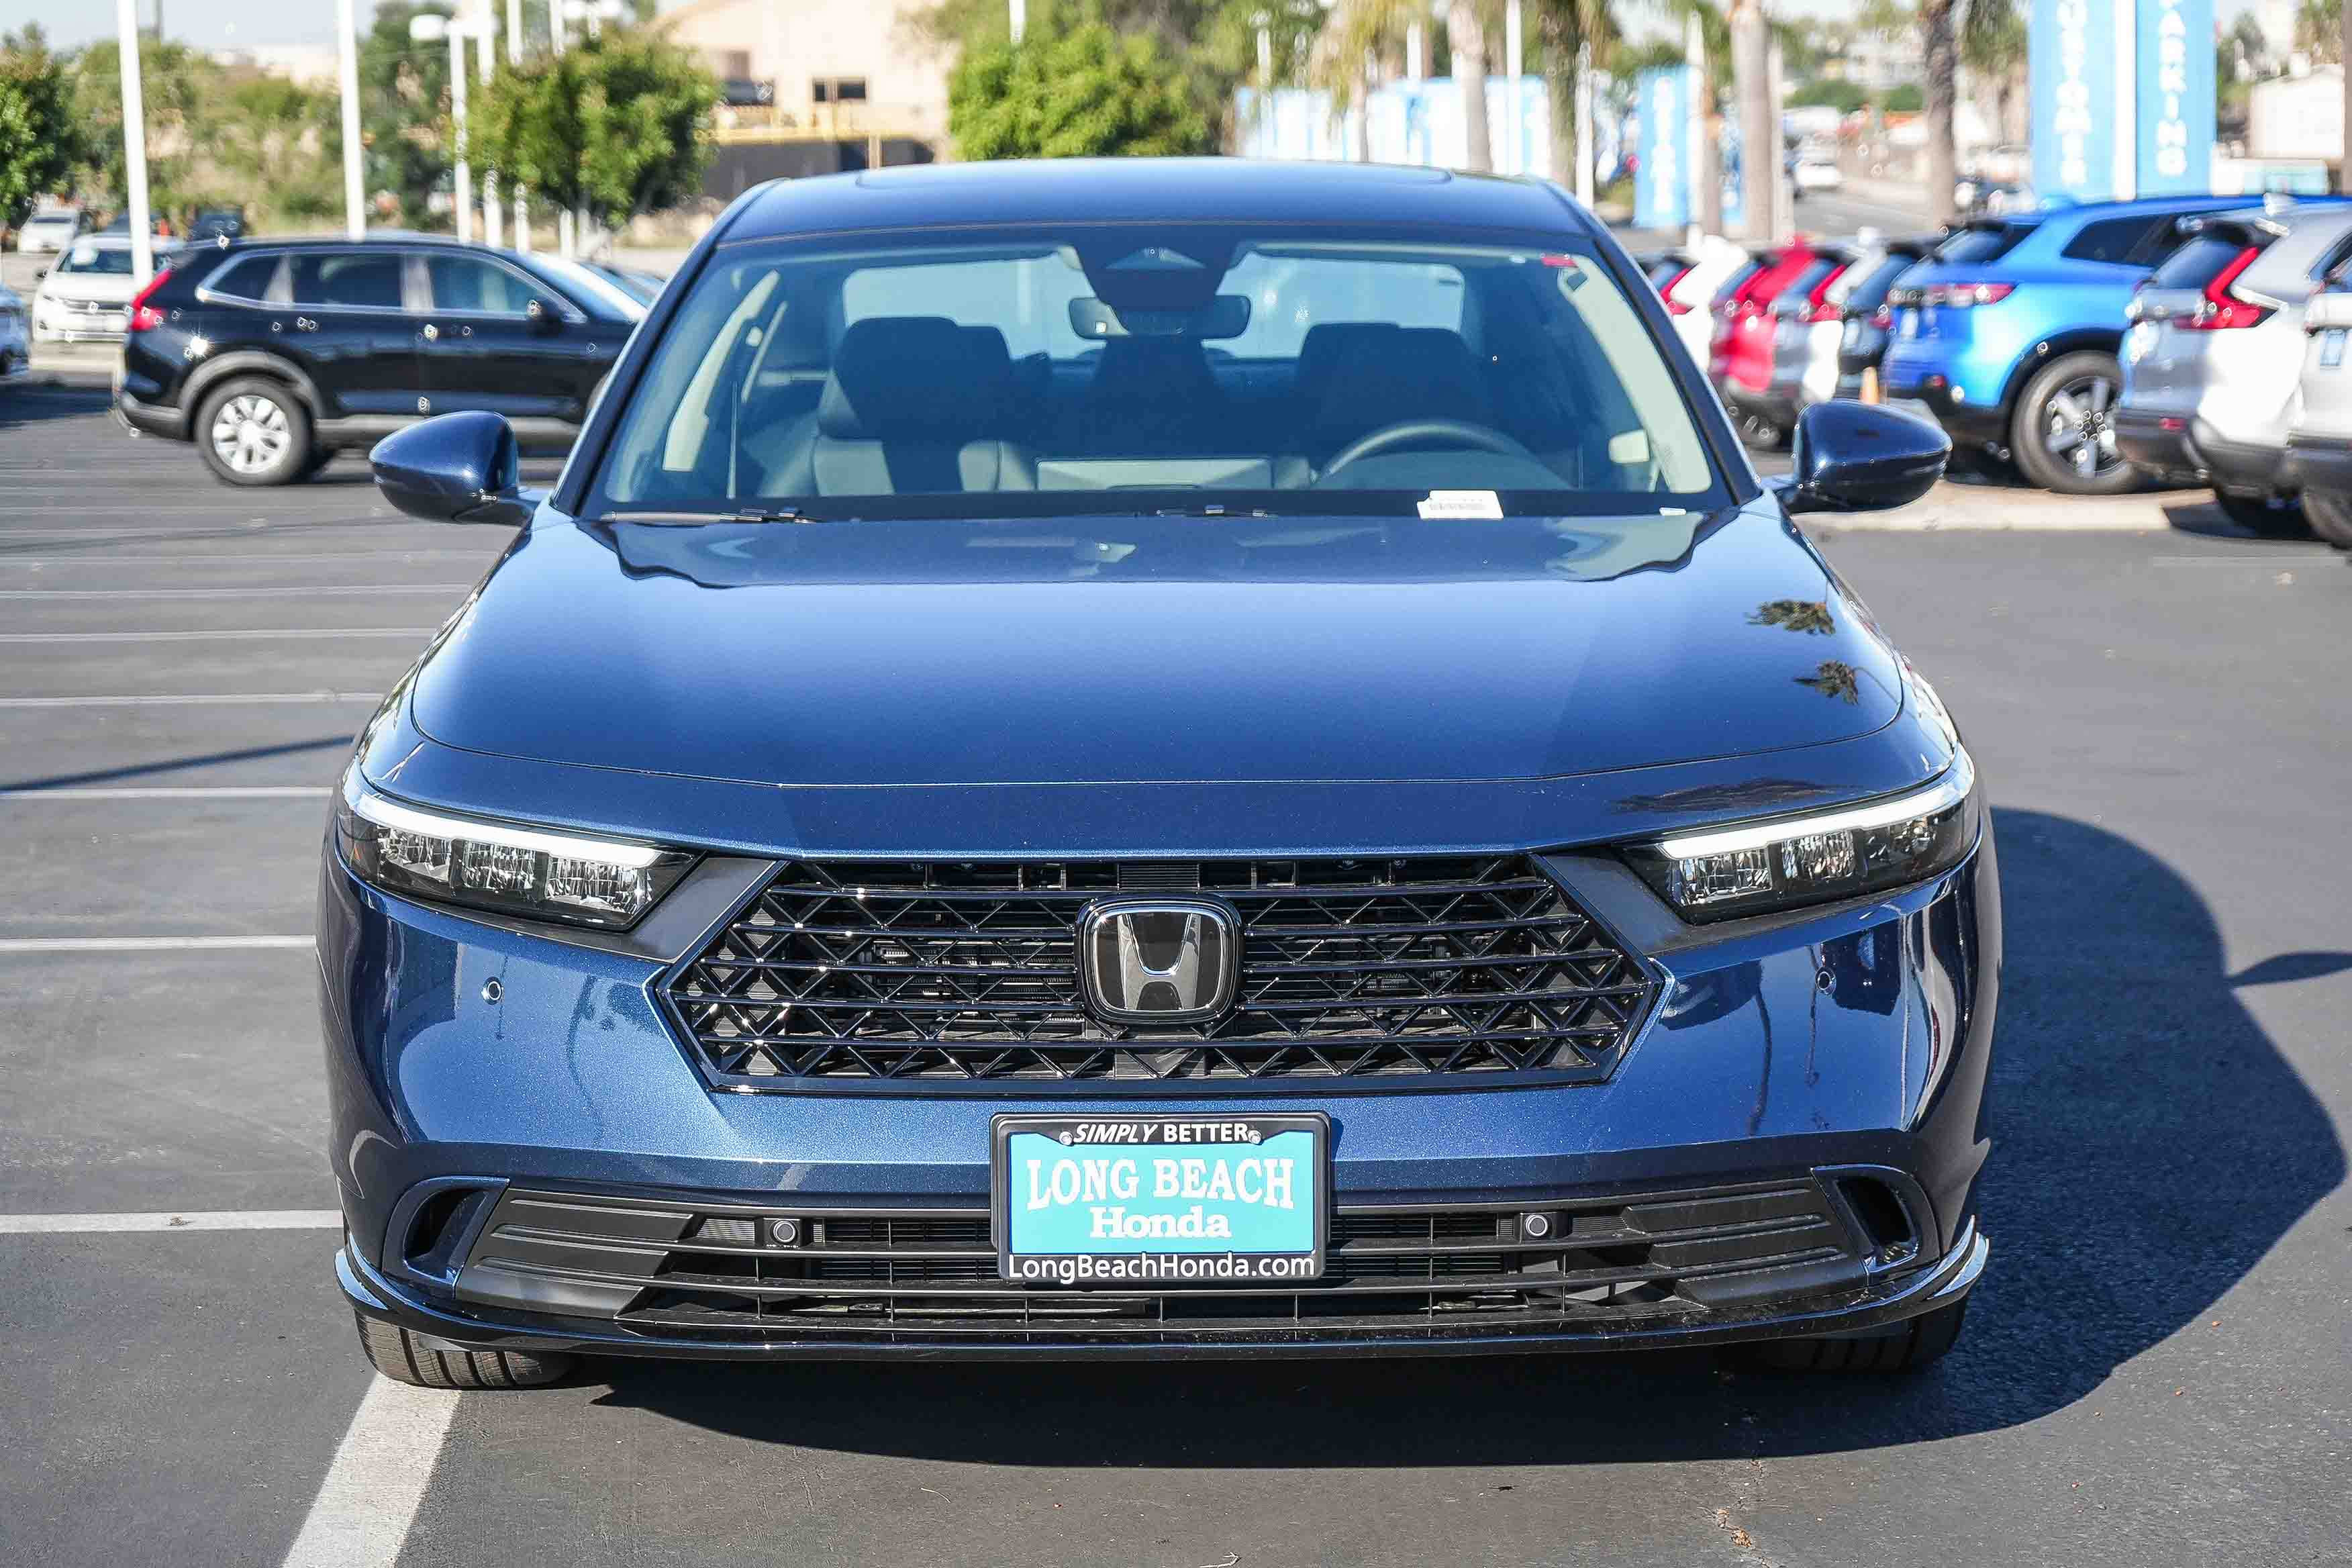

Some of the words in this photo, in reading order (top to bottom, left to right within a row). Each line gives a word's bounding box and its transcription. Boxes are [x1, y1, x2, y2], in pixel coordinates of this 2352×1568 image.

[1074, 1124, 1158, 1143] SIMPLY
[1164, 1123, 1248, 1142] BETTER
[1026, 1158, 1140, 1210] LONG
[1153, 1158, 1295, 1209] BEACH
[1089, 1206, 1232, 1239] Honda
[1008, 1252, 1315, 1283] LongBeachHonda.com
